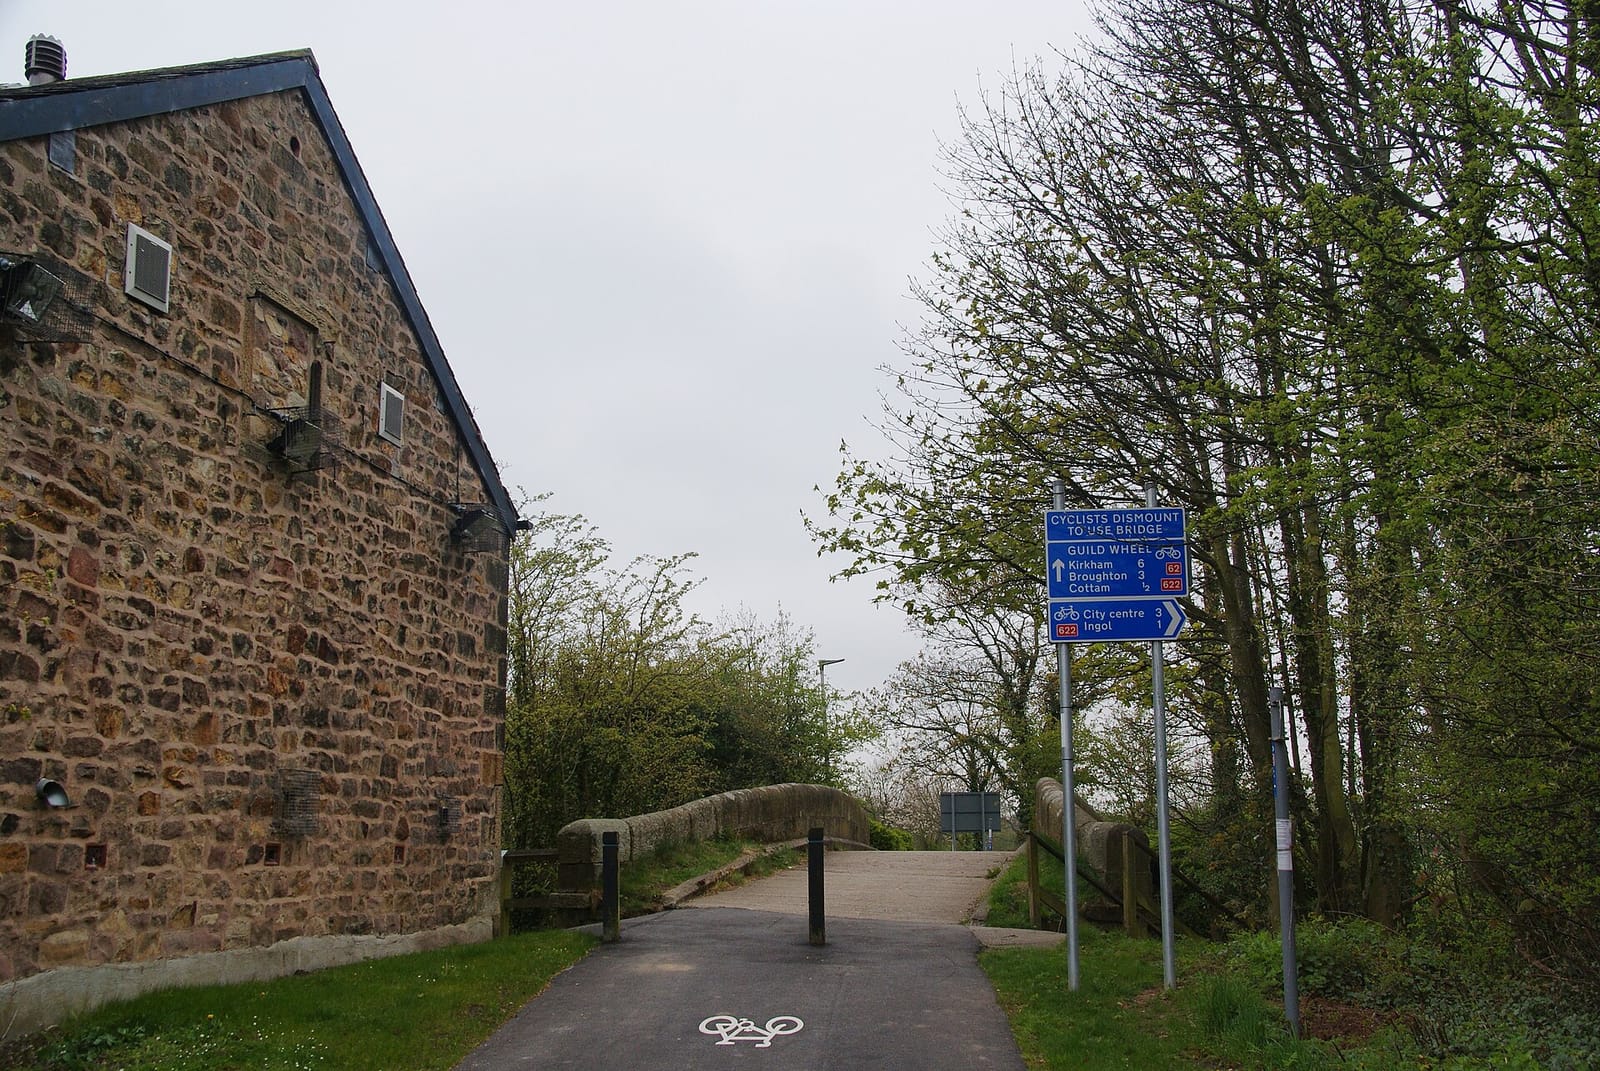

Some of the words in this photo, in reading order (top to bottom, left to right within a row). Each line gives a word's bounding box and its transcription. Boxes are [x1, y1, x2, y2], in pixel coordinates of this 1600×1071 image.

[1051, 514, 1108, 525] CYCLISTS
[1113, 512, 1179, 523] DISMOUNT
[1067, 526, 1083, 536] TO
[1088, 525, 1111, 536] USE
[1117, 524, 1162, 535] BRIDGE
[1067, 545, 1105, 556] GUILD
[1110, 544, 1152, 555] WHEEL
[1068, 560, 1113, 569] Kirkham
[1137, 558, 1145, 568] 6
[1168, 564, 1180, 573] 62
[1069, 571, 1127, 583] Broughton
[1137, 570, 1145, 580] 3
[1069, 583, 1110, 593] Cottam
[1163, 580, 1181, 589] 622
[1083, 609, 1106, 620] City
[1109, 608, 1145, 618] centre
[1155, 608, 1162, 617] 3
[1058, 626, 1077, 635] 622
[1084, 621, 1112, 632] Ingol
